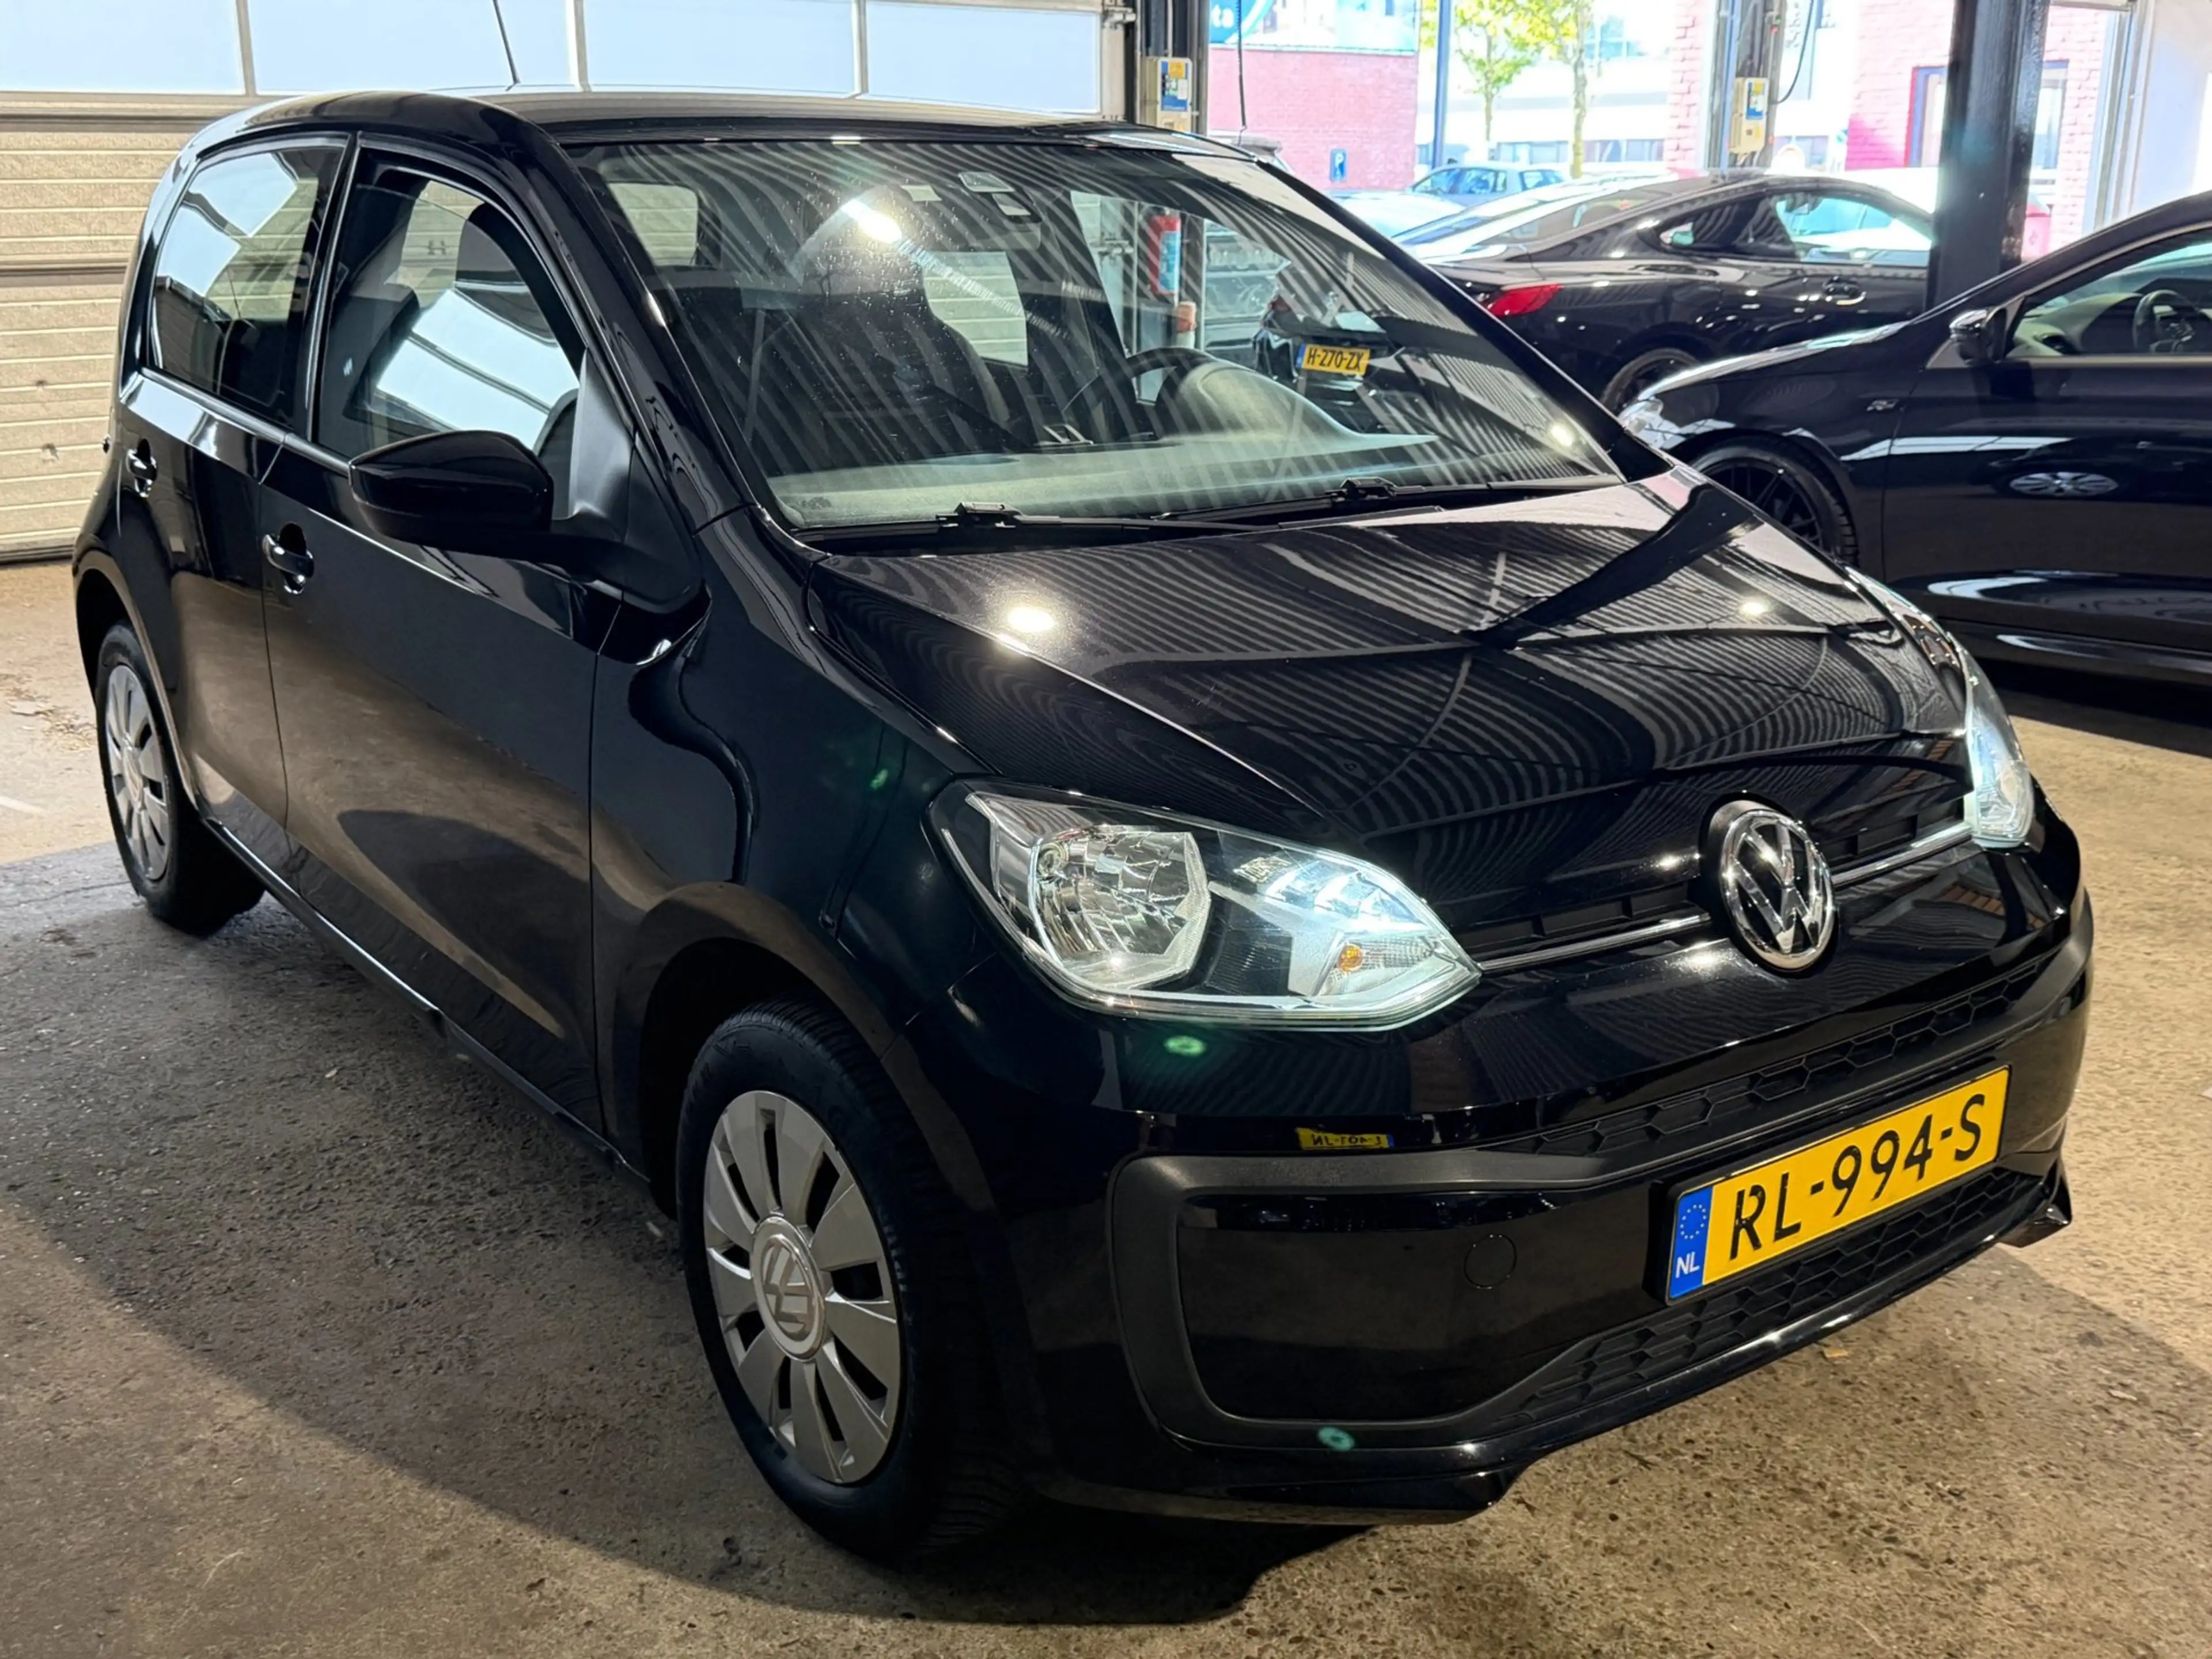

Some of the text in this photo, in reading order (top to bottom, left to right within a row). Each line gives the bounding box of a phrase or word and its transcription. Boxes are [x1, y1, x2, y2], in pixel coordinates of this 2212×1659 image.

[1307, 347, 1365, 372] H-270-ZX
[1729, 1093, 1986, 1260] RL-994-S
[1675, 1251, 1700, 1279] NL
